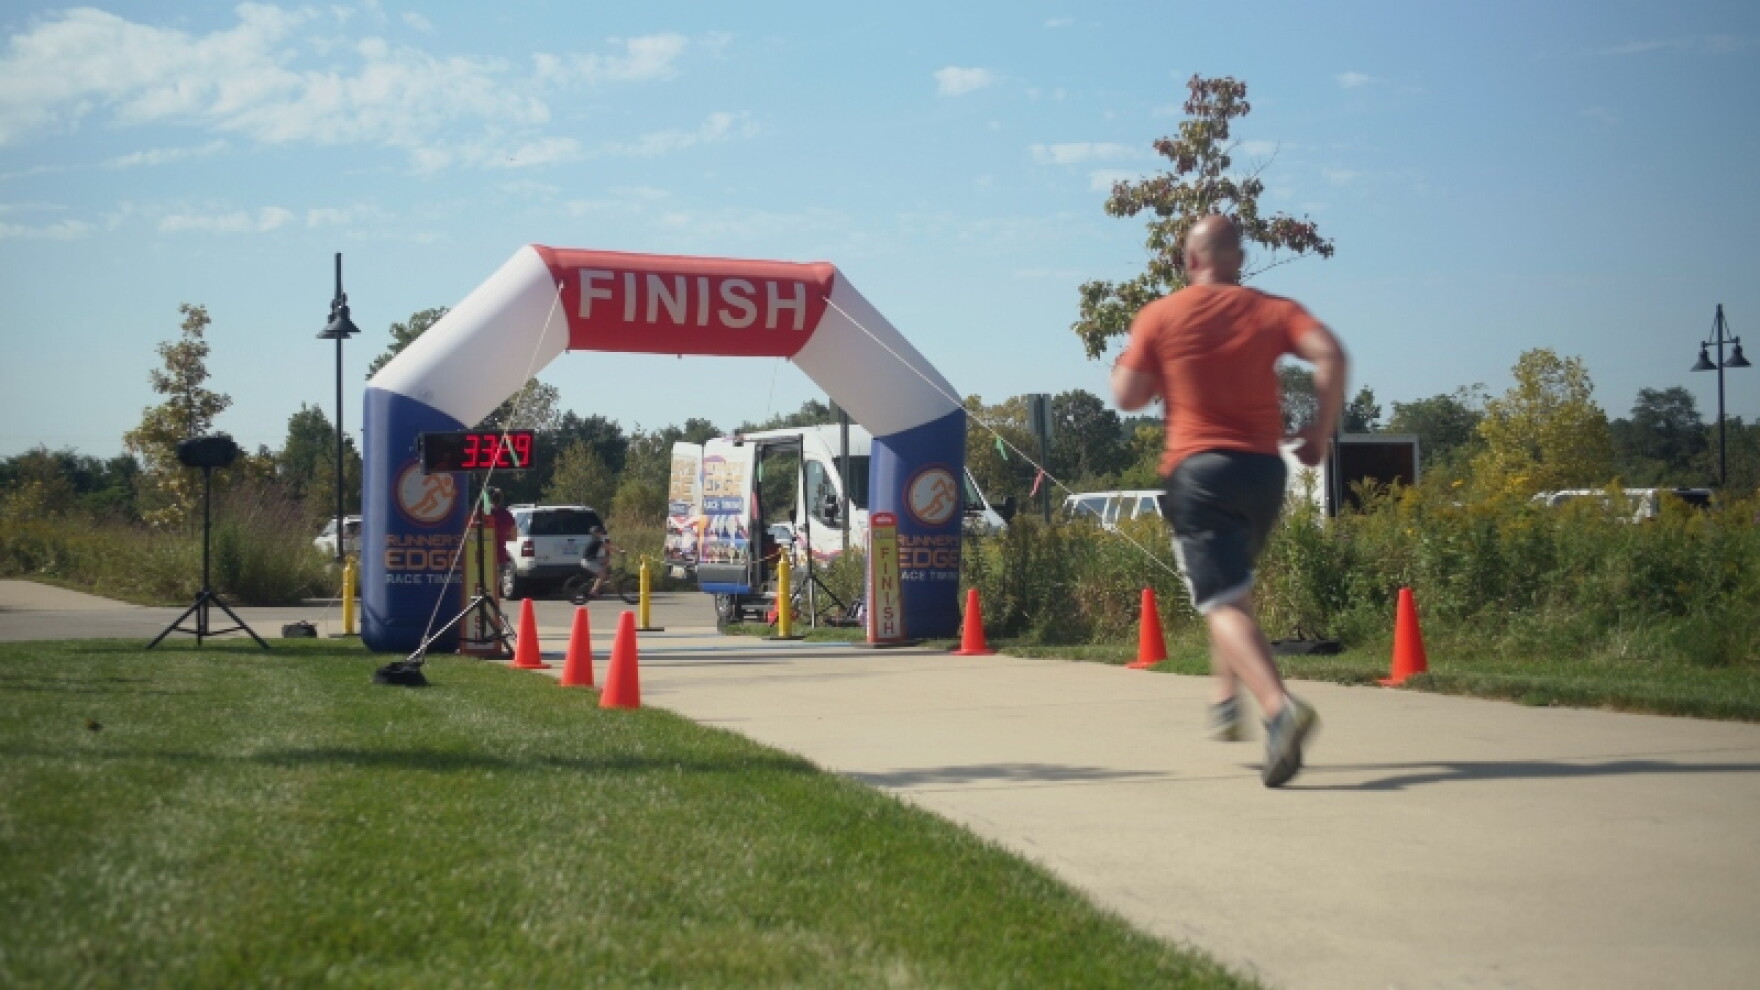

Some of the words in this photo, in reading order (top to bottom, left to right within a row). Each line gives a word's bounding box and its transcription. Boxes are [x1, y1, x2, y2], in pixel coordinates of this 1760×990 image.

[578, 268, 806, 331] FINISH
[384, 549, 463, 570] EDGE
[897, 548, 959, 568] EDGE
[385, 573, 422, 583] RACE
[901, 571, 925, 580] ACE
[881, 547, 893, 634] FINISH
